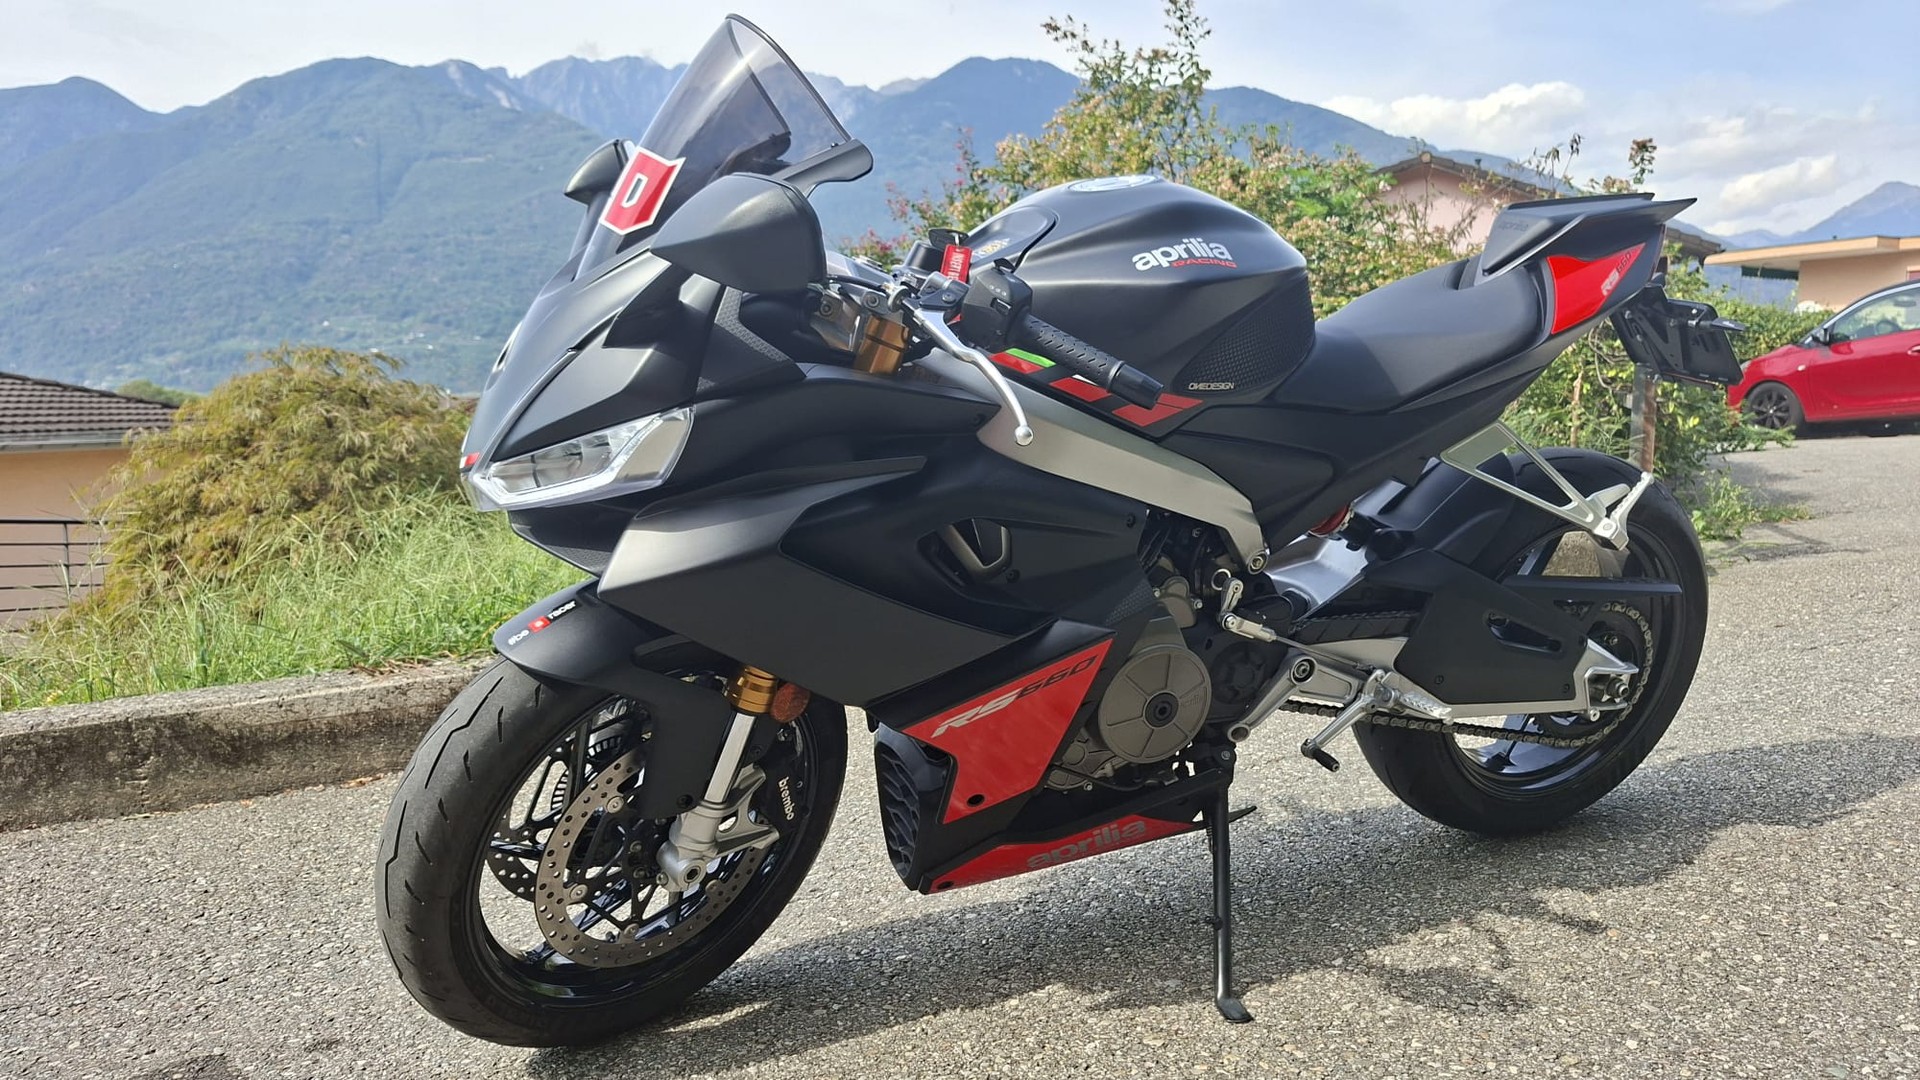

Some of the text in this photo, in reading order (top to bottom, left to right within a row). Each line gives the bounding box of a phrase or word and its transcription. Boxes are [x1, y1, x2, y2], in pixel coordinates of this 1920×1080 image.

[1132, 238, 1233, 271] aprilia
[1171, 258, 1237, 269] RACING
[547, 600, 576, 619] racer
[778, 776, 795, 821] brembo
[1027, 820, 1145, 868] aprilia
